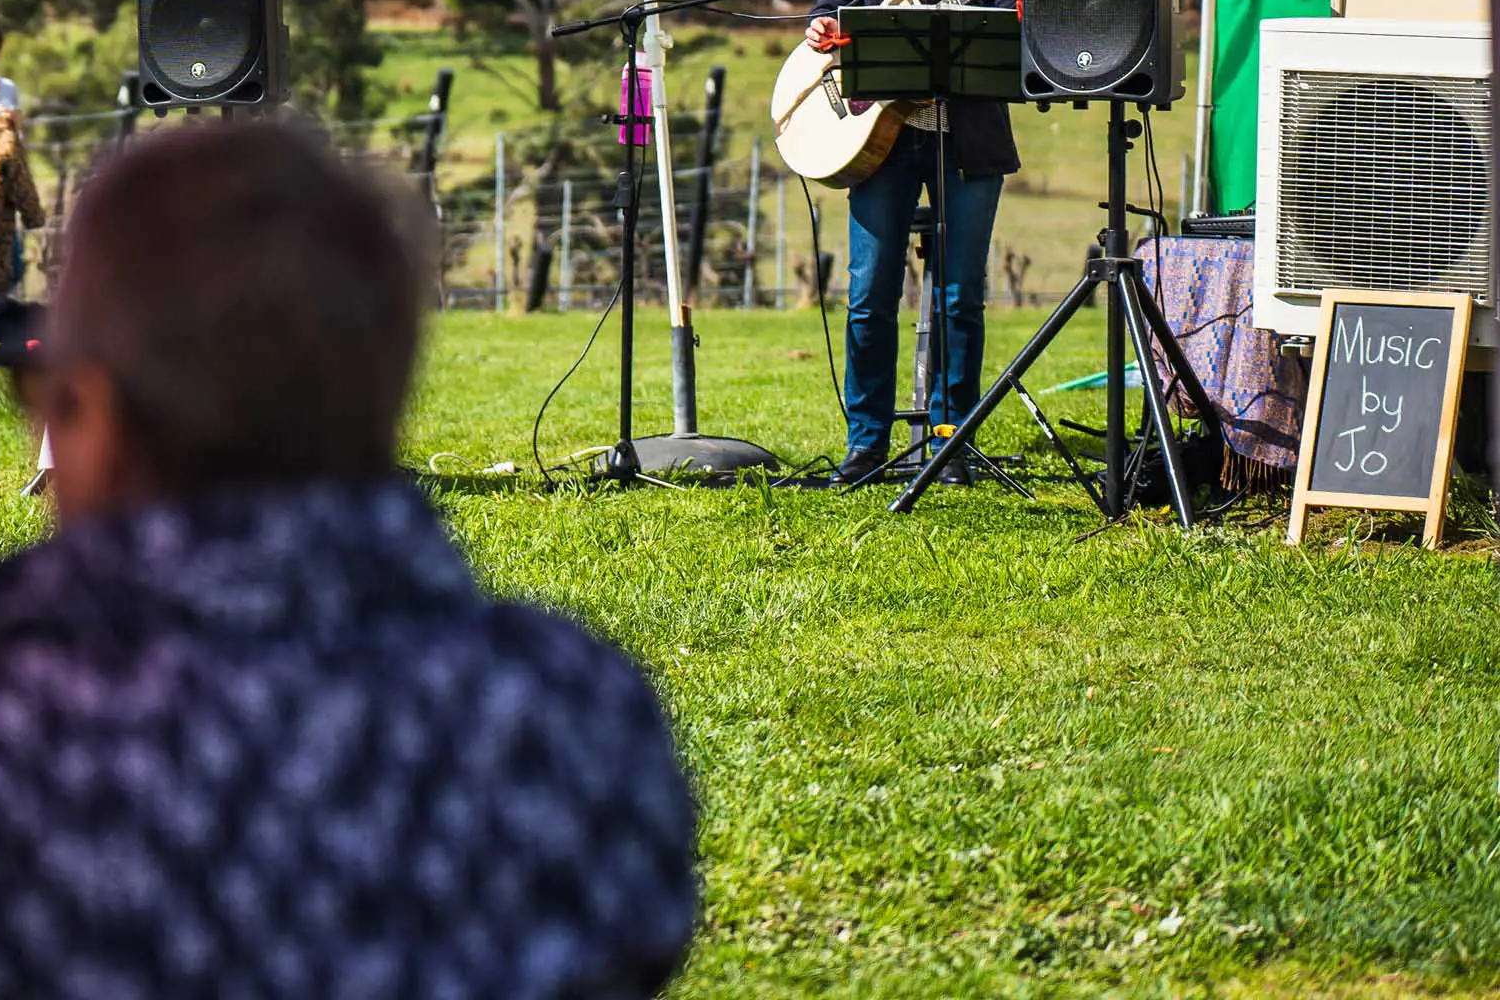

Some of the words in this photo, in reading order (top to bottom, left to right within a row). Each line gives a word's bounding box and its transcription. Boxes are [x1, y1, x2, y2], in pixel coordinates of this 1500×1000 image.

[1334, 316, 1442, 369] Music
[1361, 375, 1404, 433] by
[1334, 425, 1388, 476] Jo
